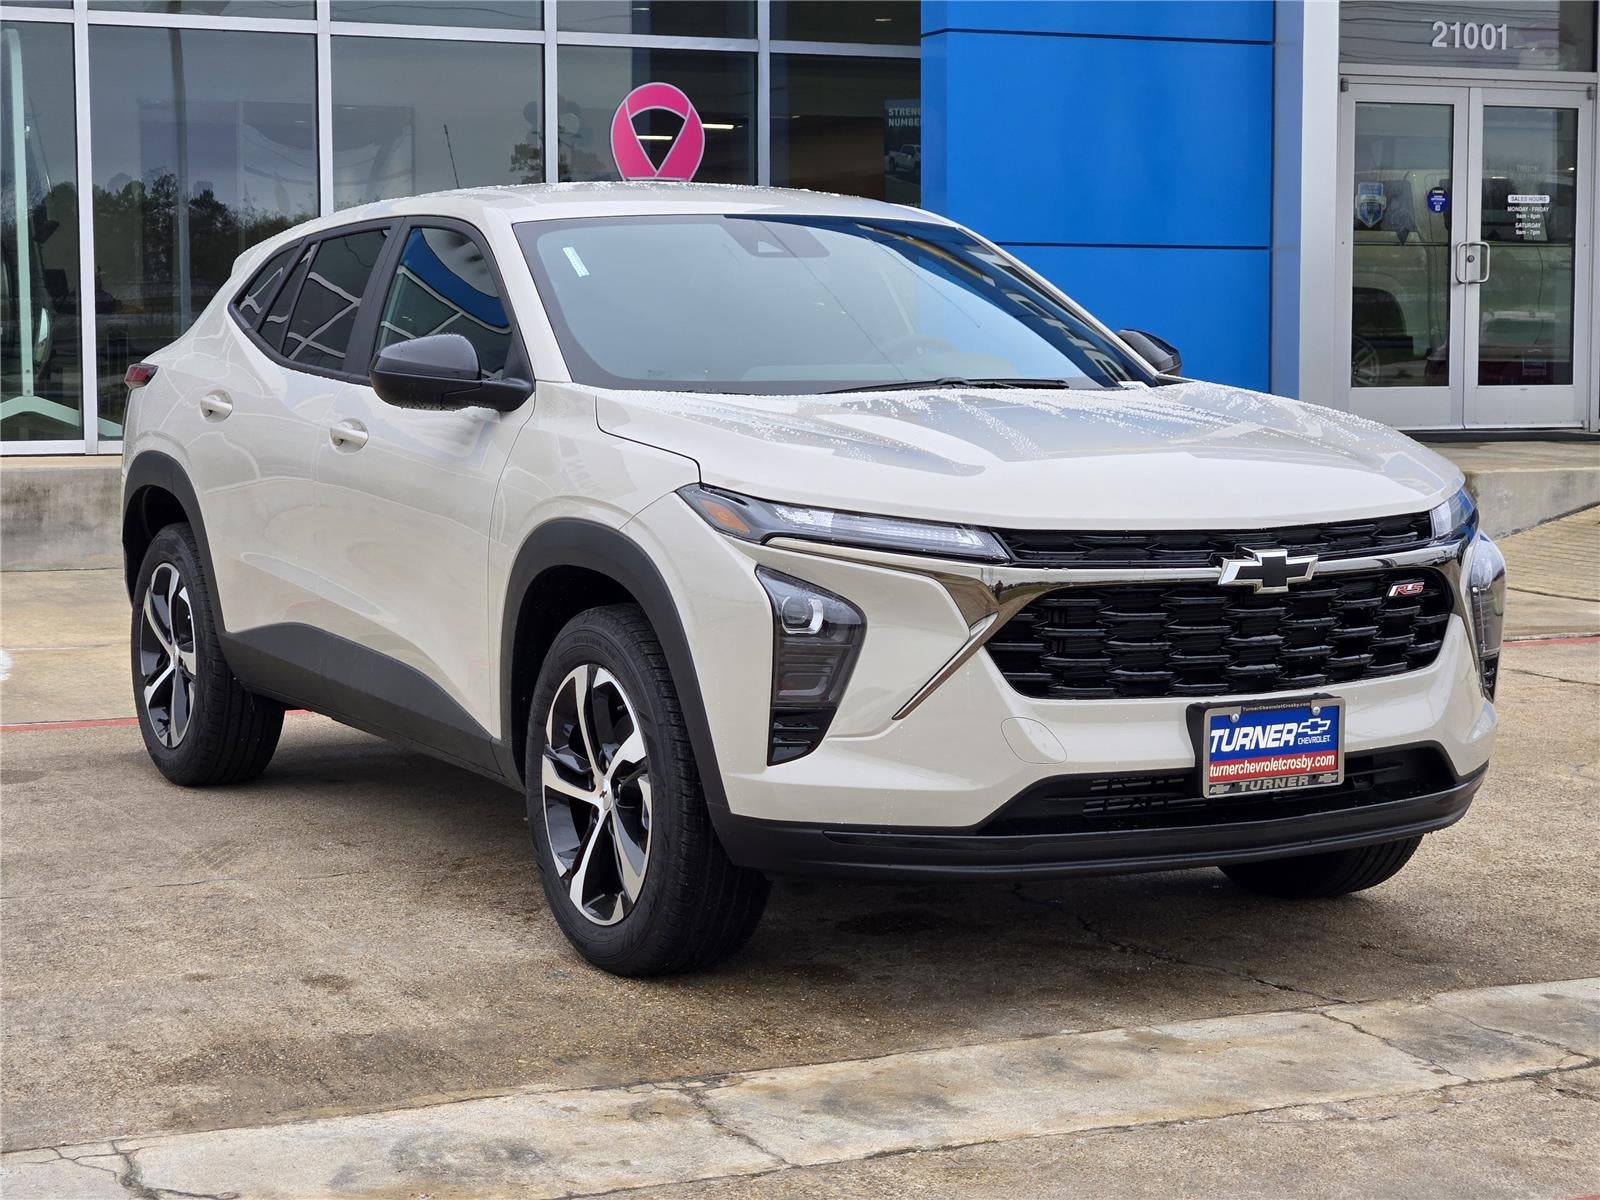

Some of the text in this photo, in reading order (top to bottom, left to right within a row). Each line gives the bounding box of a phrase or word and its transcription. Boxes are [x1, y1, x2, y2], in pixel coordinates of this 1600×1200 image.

[1431, 20, 1508, 50] 21001
[888, 117, 921, 127] NUMBE
[1388, 581, 1425, 597] RS
[1242, 702, 1311, 712] TurnerChevroletCrosby.com
[1210, 722, 1299, 754] TURNER
[1297, 734, 1331, 745] CHEVROLET
[1209, 753, 1335, 777] turnerchevroletcrosby.com
[1239, 775, 1309, 792] TURNER
